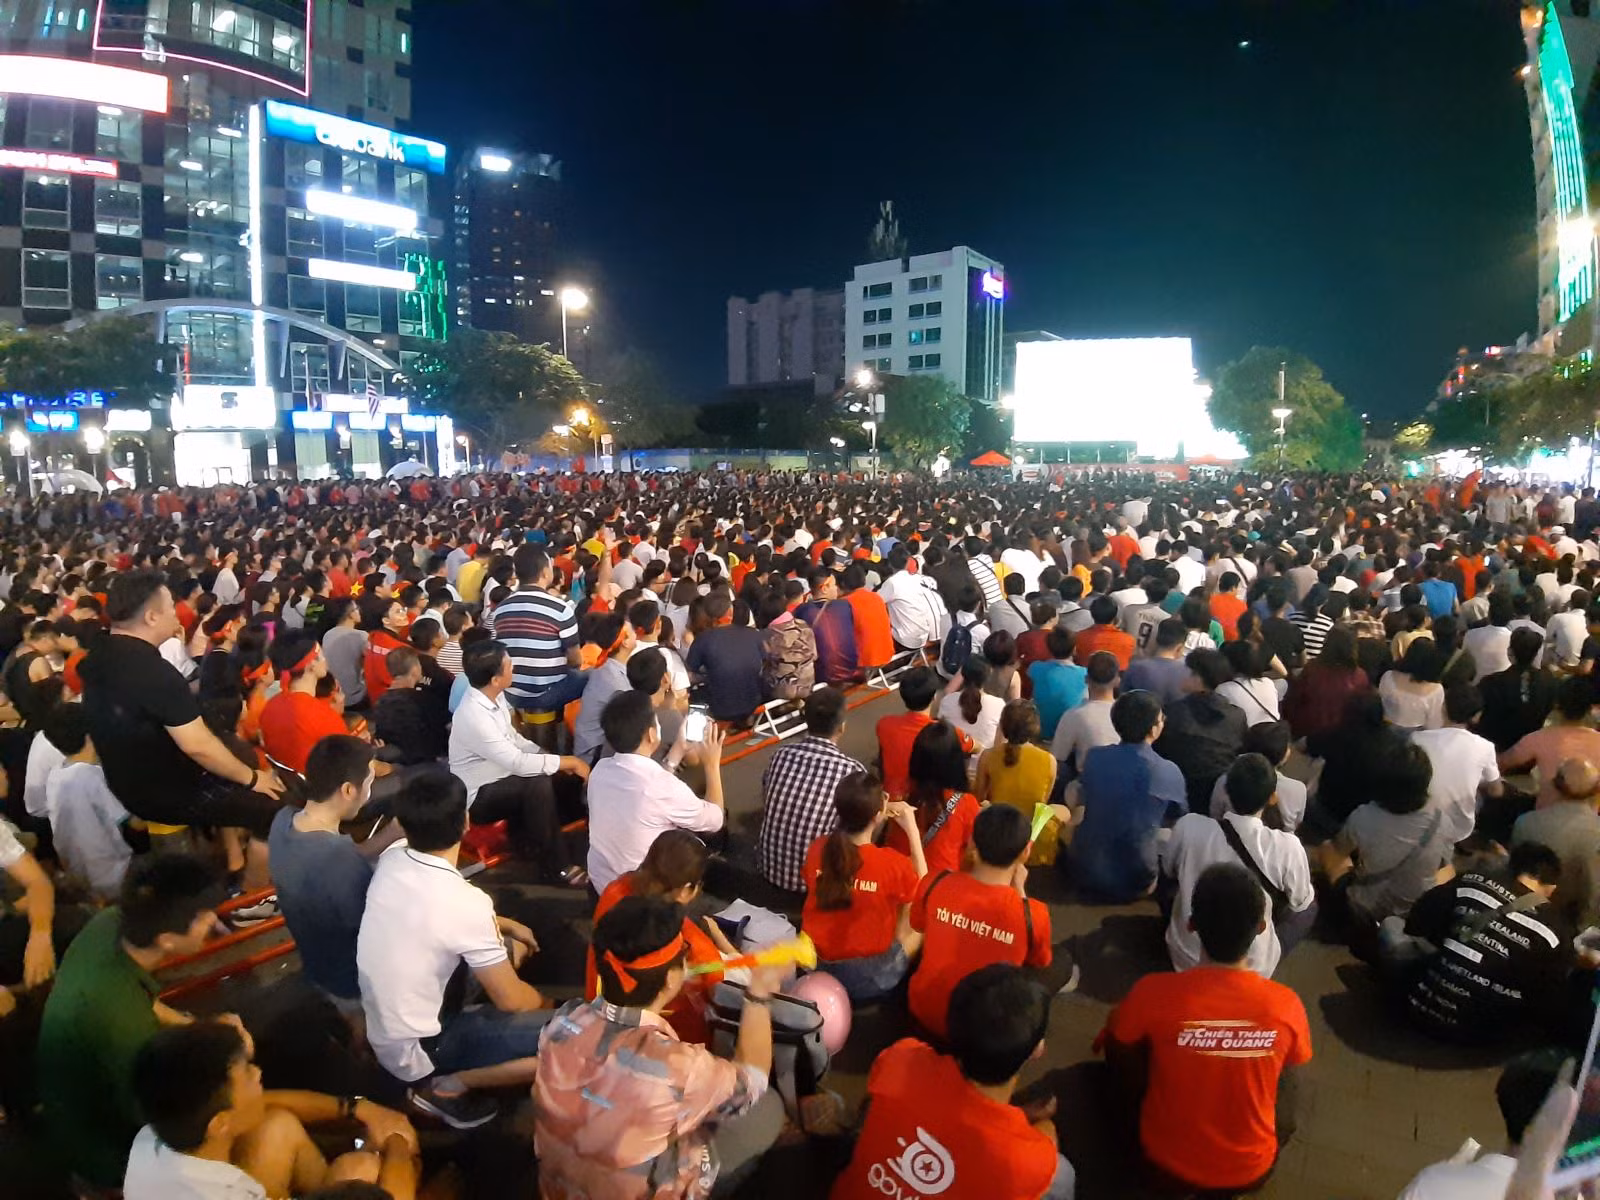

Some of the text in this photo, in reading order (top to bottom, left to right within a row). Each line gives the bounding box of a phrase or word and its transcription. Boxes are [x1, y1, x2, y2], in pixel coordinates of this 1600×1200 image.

[1138, 622, 1153, 649] 9
[860, 880, 878, 893] NAM
[936, 907, 950, 923] TÔI
[951, 913, 969, 930] YÊU
[992, 927, 1014, 945] NAM
[1489, 919, 1531, 946] ZEALAND
[1177, 1032, 1274, 1048] VINH QUANG
